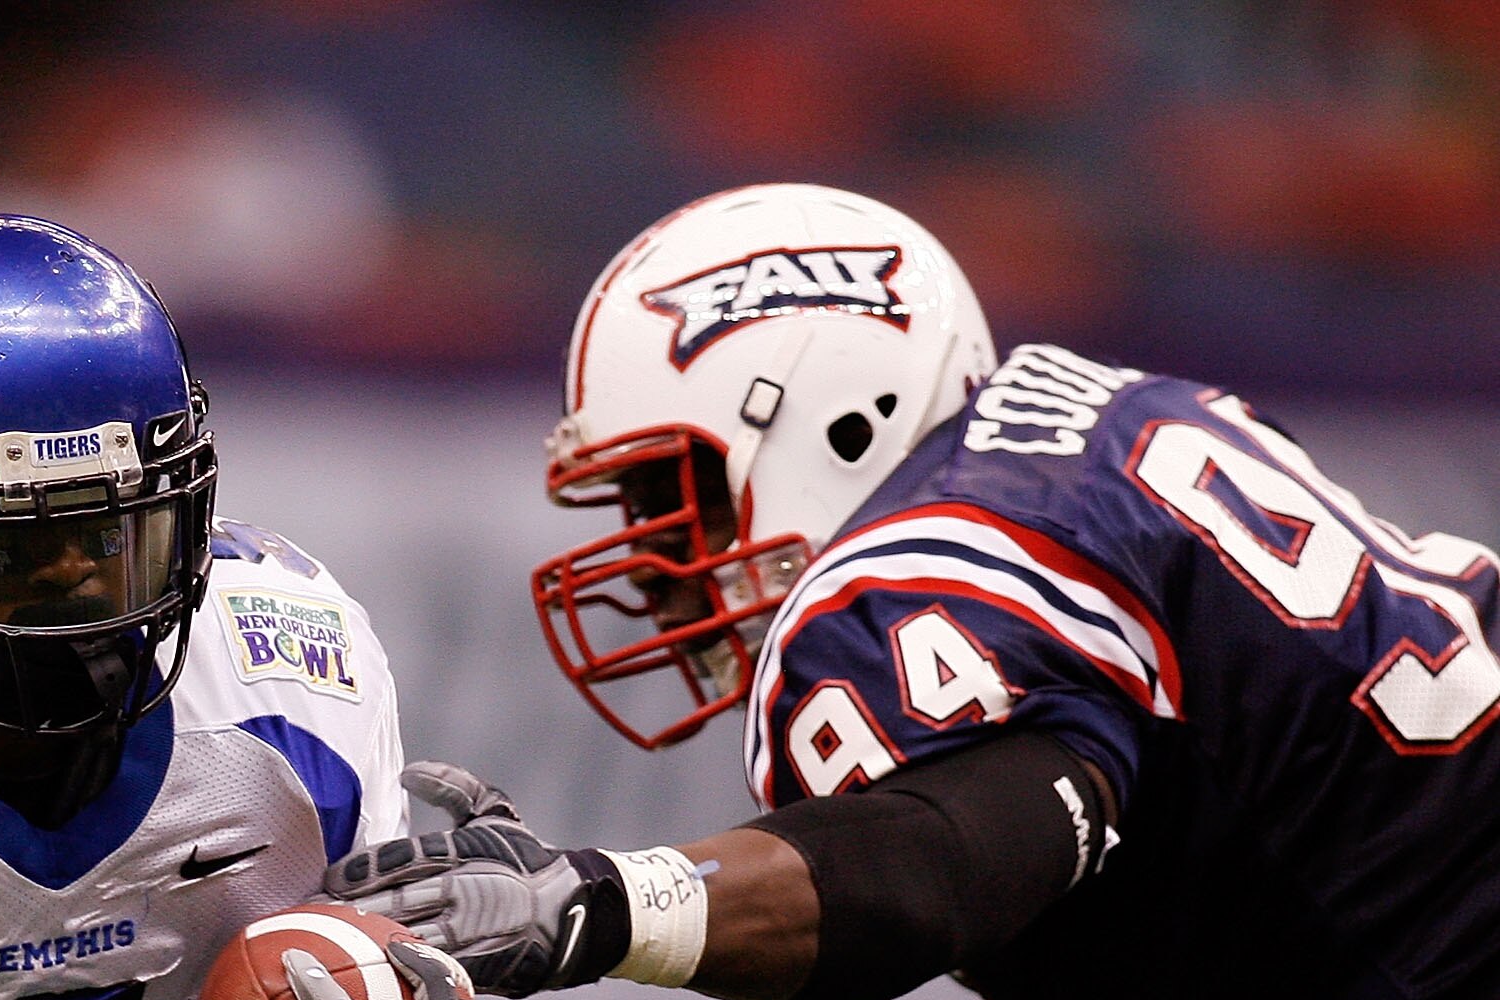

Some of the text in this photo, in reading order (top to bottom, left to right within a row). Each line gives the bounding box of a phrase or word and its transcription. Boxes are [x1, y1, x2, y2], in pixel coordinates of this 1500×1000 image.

[650, 250, 896, 348] FAU
[964, 343, 1145, 456] COU
[34, 433, 100, 460] TIGERS
[235, 615, 346, 647] NEW ORLEANS
[242, 631, 354, 687] BOWL
